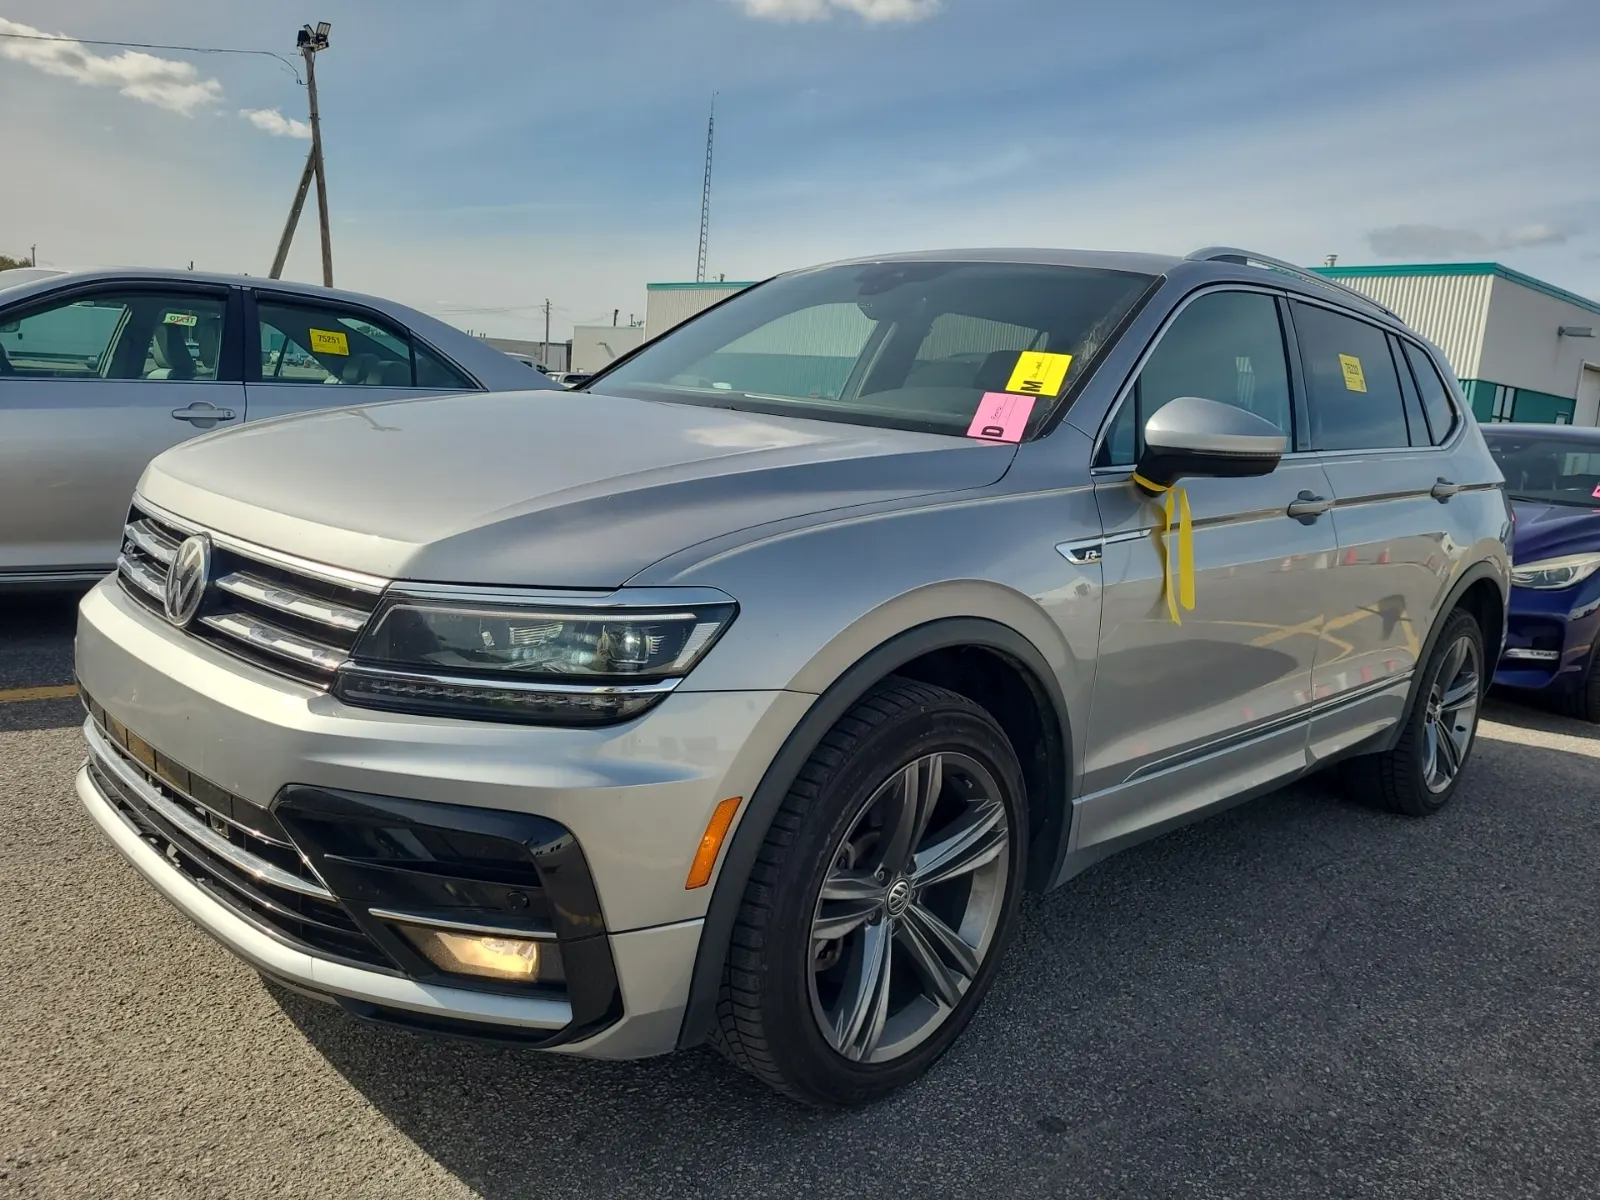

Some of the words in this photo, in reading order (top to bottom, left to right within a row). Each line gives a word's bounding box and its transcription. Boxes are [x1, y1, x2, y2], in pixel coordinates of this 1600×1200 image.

[317, 334, 341, 344] 75251
[1019, 380, 1044, 392] M
[981, 425, 1005, 438] D
